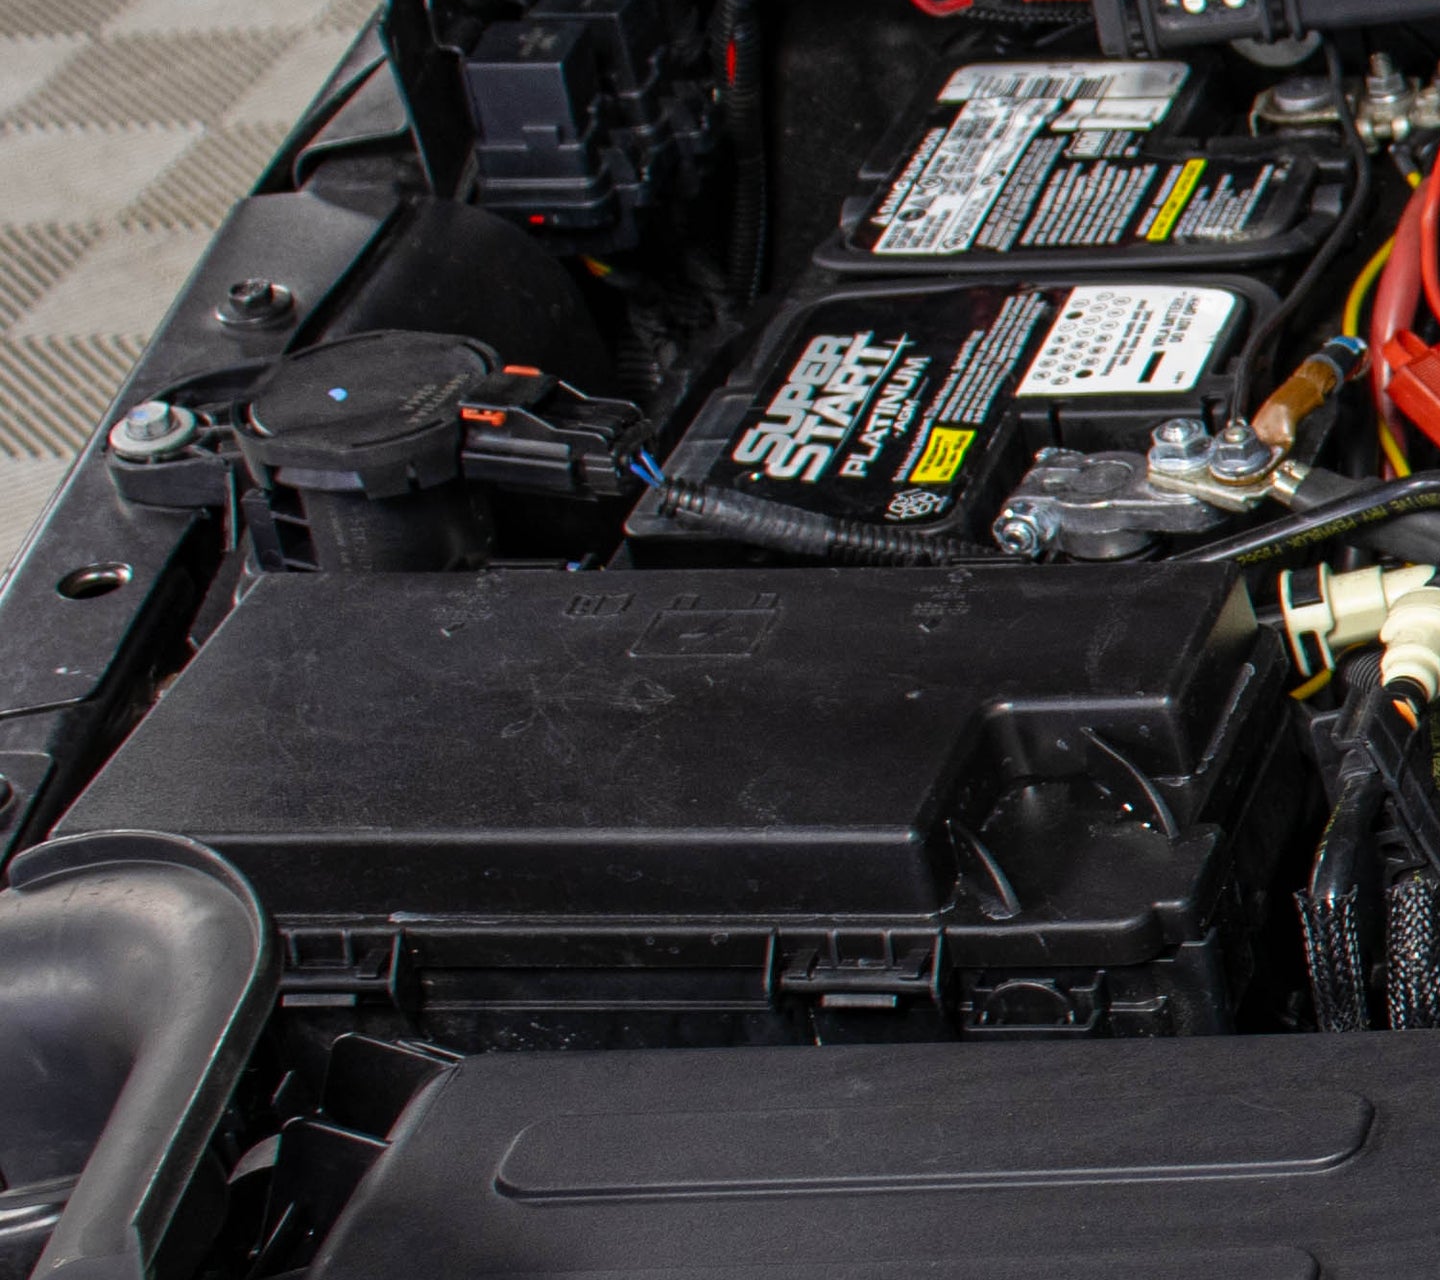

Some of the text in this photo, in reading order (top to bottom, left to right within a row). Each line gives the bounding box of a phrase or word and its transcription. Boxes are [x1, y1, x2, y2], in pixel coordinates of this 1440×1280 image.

[733, 334, 854, 464] SUPER
[765, 331, 888, 483] START
[839, 355, 932, 478] PLATINUM
